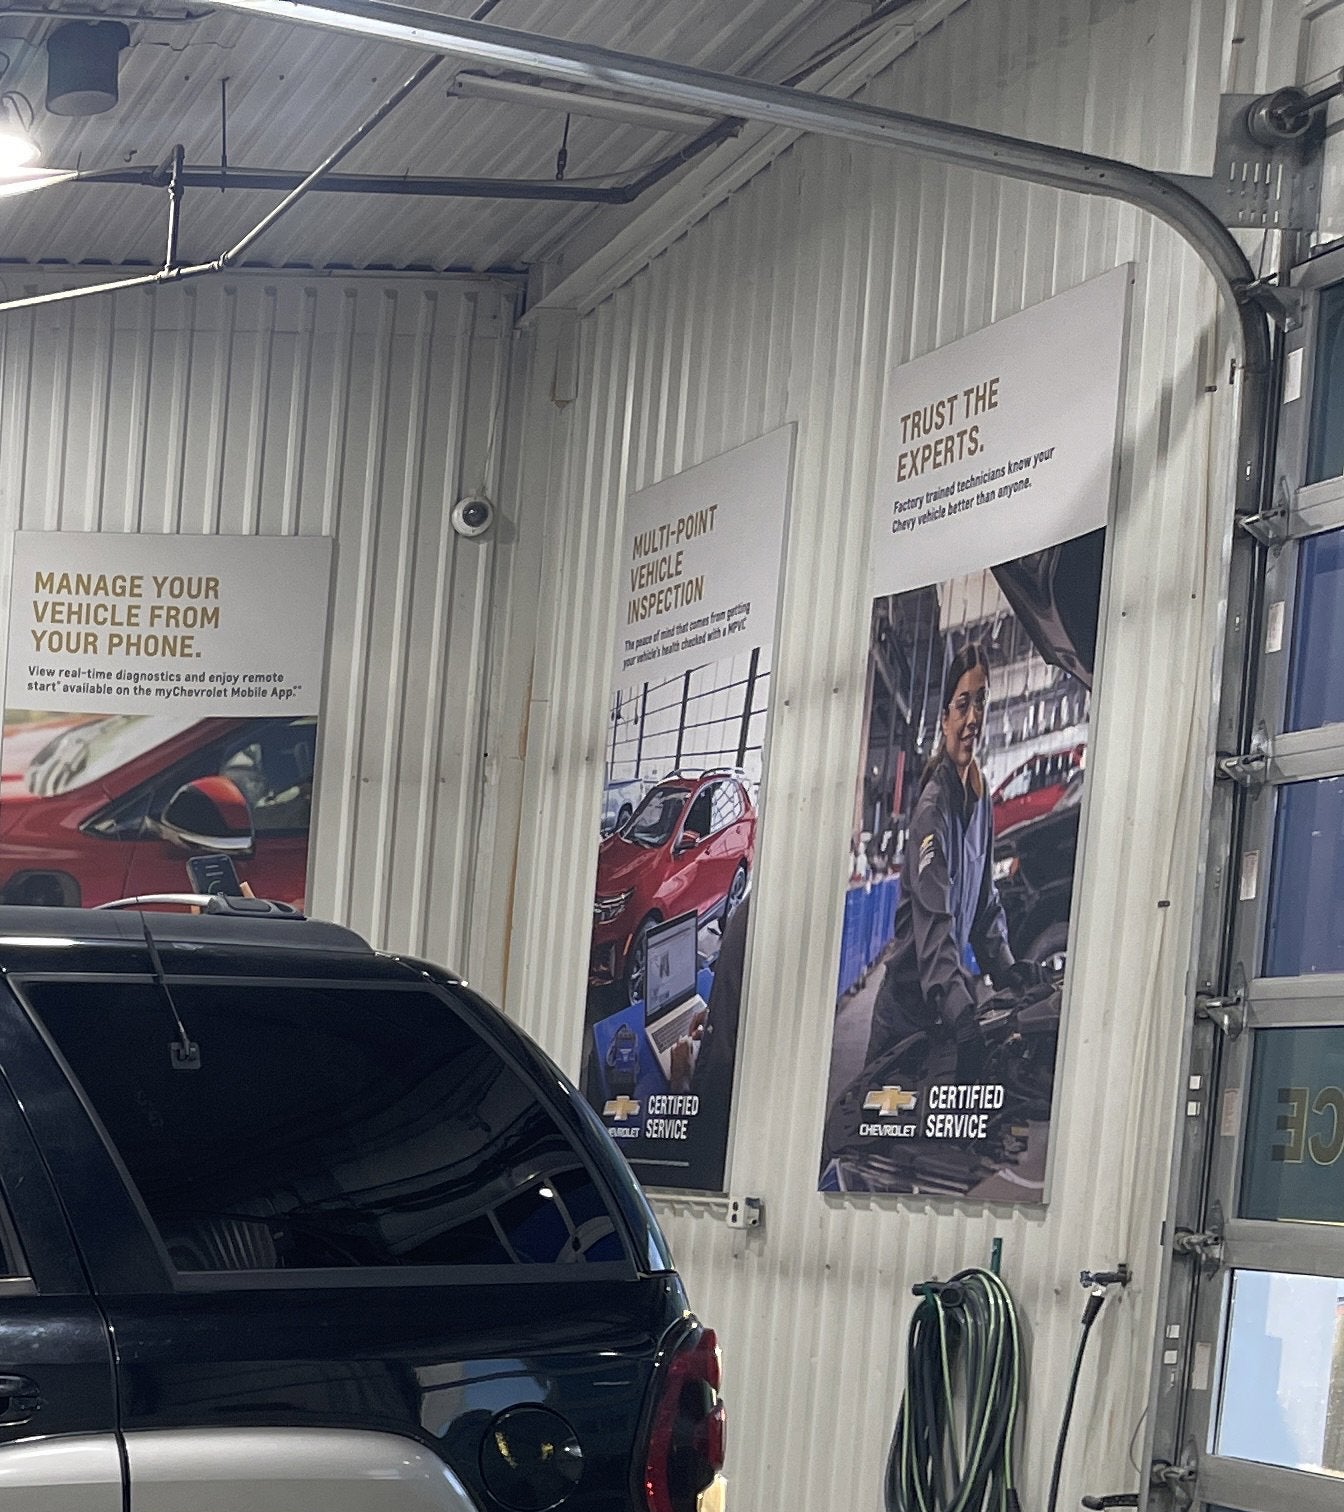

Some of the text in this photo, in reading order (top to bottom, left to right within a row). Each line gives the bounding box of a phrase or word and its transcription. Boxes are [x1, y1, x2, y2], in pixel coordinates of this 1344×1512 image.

[900, 377, 1000, 444] TRUST THE
[897, 424, 984, 483] EXPERTS.
[893, 446, 1056, 514] Factory trained technicians know your
[892, 517, 917, 533] Chevy
[917, 505, 946, 525] vehicle
[947, 496, 975, 516] better
[976, 489, 996, 506] than
[632, 504, 718, 561] MULTI-POINT
[34, 571, 220, 600] MANAGE YOUR
[630, 551, 684, 593] VEHICLE
[33, 600, 220, 629] VEHICLE FROM
[627, 575, 705, 625] INSPECTION
[31, 629, 201, 658] YOUR PHONE.
[28, 665, 284, 686] View real-time diagnostics and enjoy remote
[62, 682, 113, 694] available
[116, 686, 130, 696] on
[133, 685, 152, 696] the
[155, 686, 228, 699] myChevrolet
[231, 686, 268, 698] Mobile
[648, 1095, 700, 1116] CERTIFIED
[928, 1085, 1005, 1110] CERTIFIED
[645, 1119, 688, 1139] SERVICE
[859, 1124, 916, 1137] CHEVROLET
[925, 1114, 988, 1139] SERVICE
